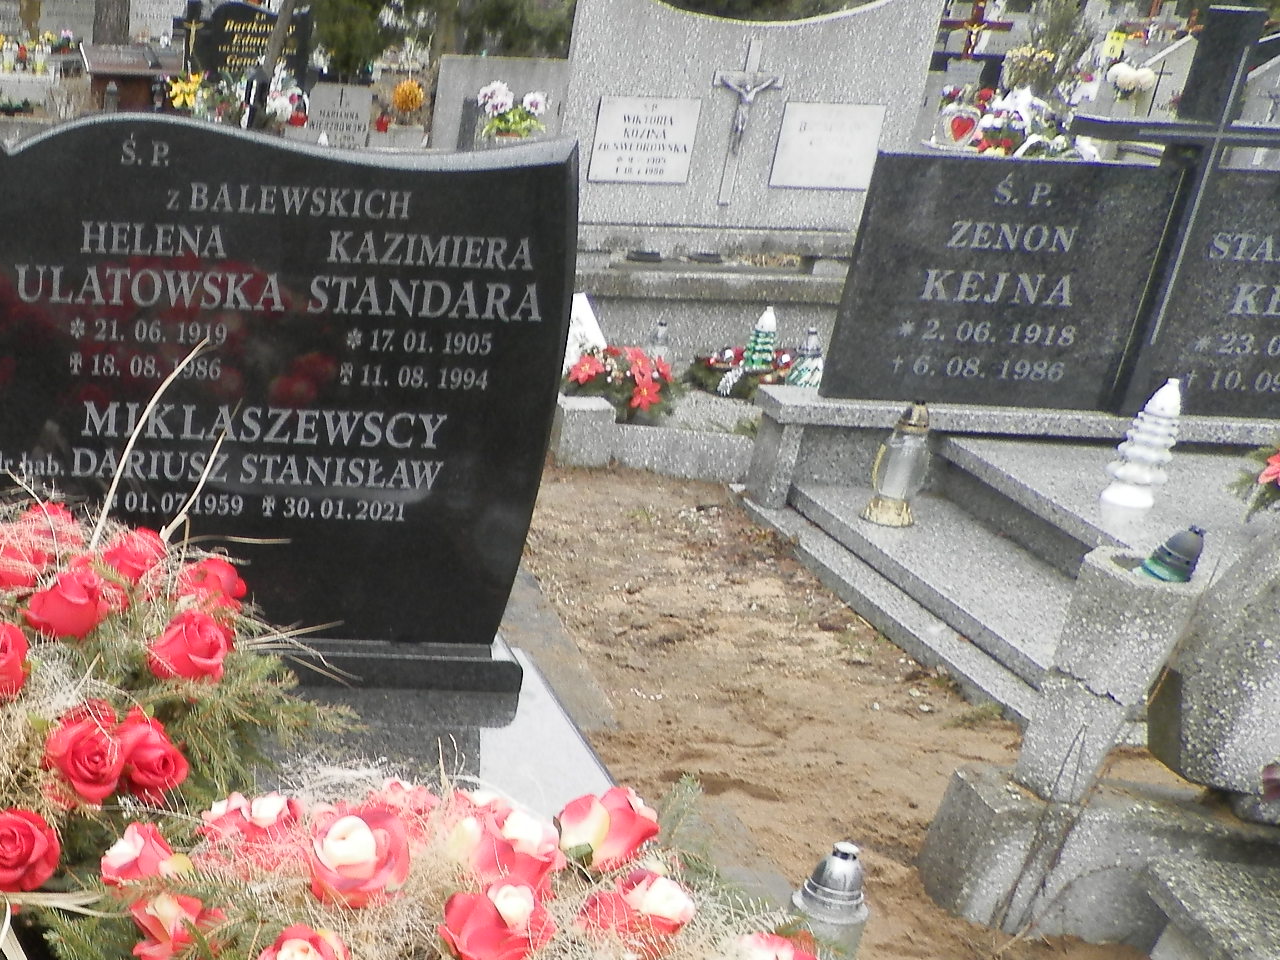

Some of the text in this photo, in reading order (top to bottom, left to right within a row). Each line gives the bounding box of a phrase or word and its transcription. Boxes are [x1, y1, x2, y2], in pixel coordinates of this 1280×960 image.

[150, 141, 170, 166] P.
[166, 182, 412, 220] z BALEWSKICH
[994, 172, 1052, 207] Ś. P.
[80, 220, 227, 259] HELENA
[326, 230, 534, 271] KAZIMIERA
[946, 219, 1079, 253] ZENON
[1209, 232, 1280, 261] STA
[15, 264, 284, 313] ULATOWSKA
[306, 274, 542, 322] STANDARA
[921, 269, 1073, 307] KEJNA
[94, 318, 228, 346] 21. 06. 1919
[370, 329, 493, 356] 17. 01. 1905
[921, 318, 1077, 347] 2. 06. 1918
[91, 354, 121, 377] 18.
[129, 355, 161, 378] 08.
[360, 363, 489, 391] 11. 08. 1994
[912, 355, 1065, 382] 6. 08. 1986
[81, 400, 448, 450] MIKLASZEWSCY
[71, 447, 229, 483] DARIUSZ
[239, 453, 444, 491] STANISŁAW
